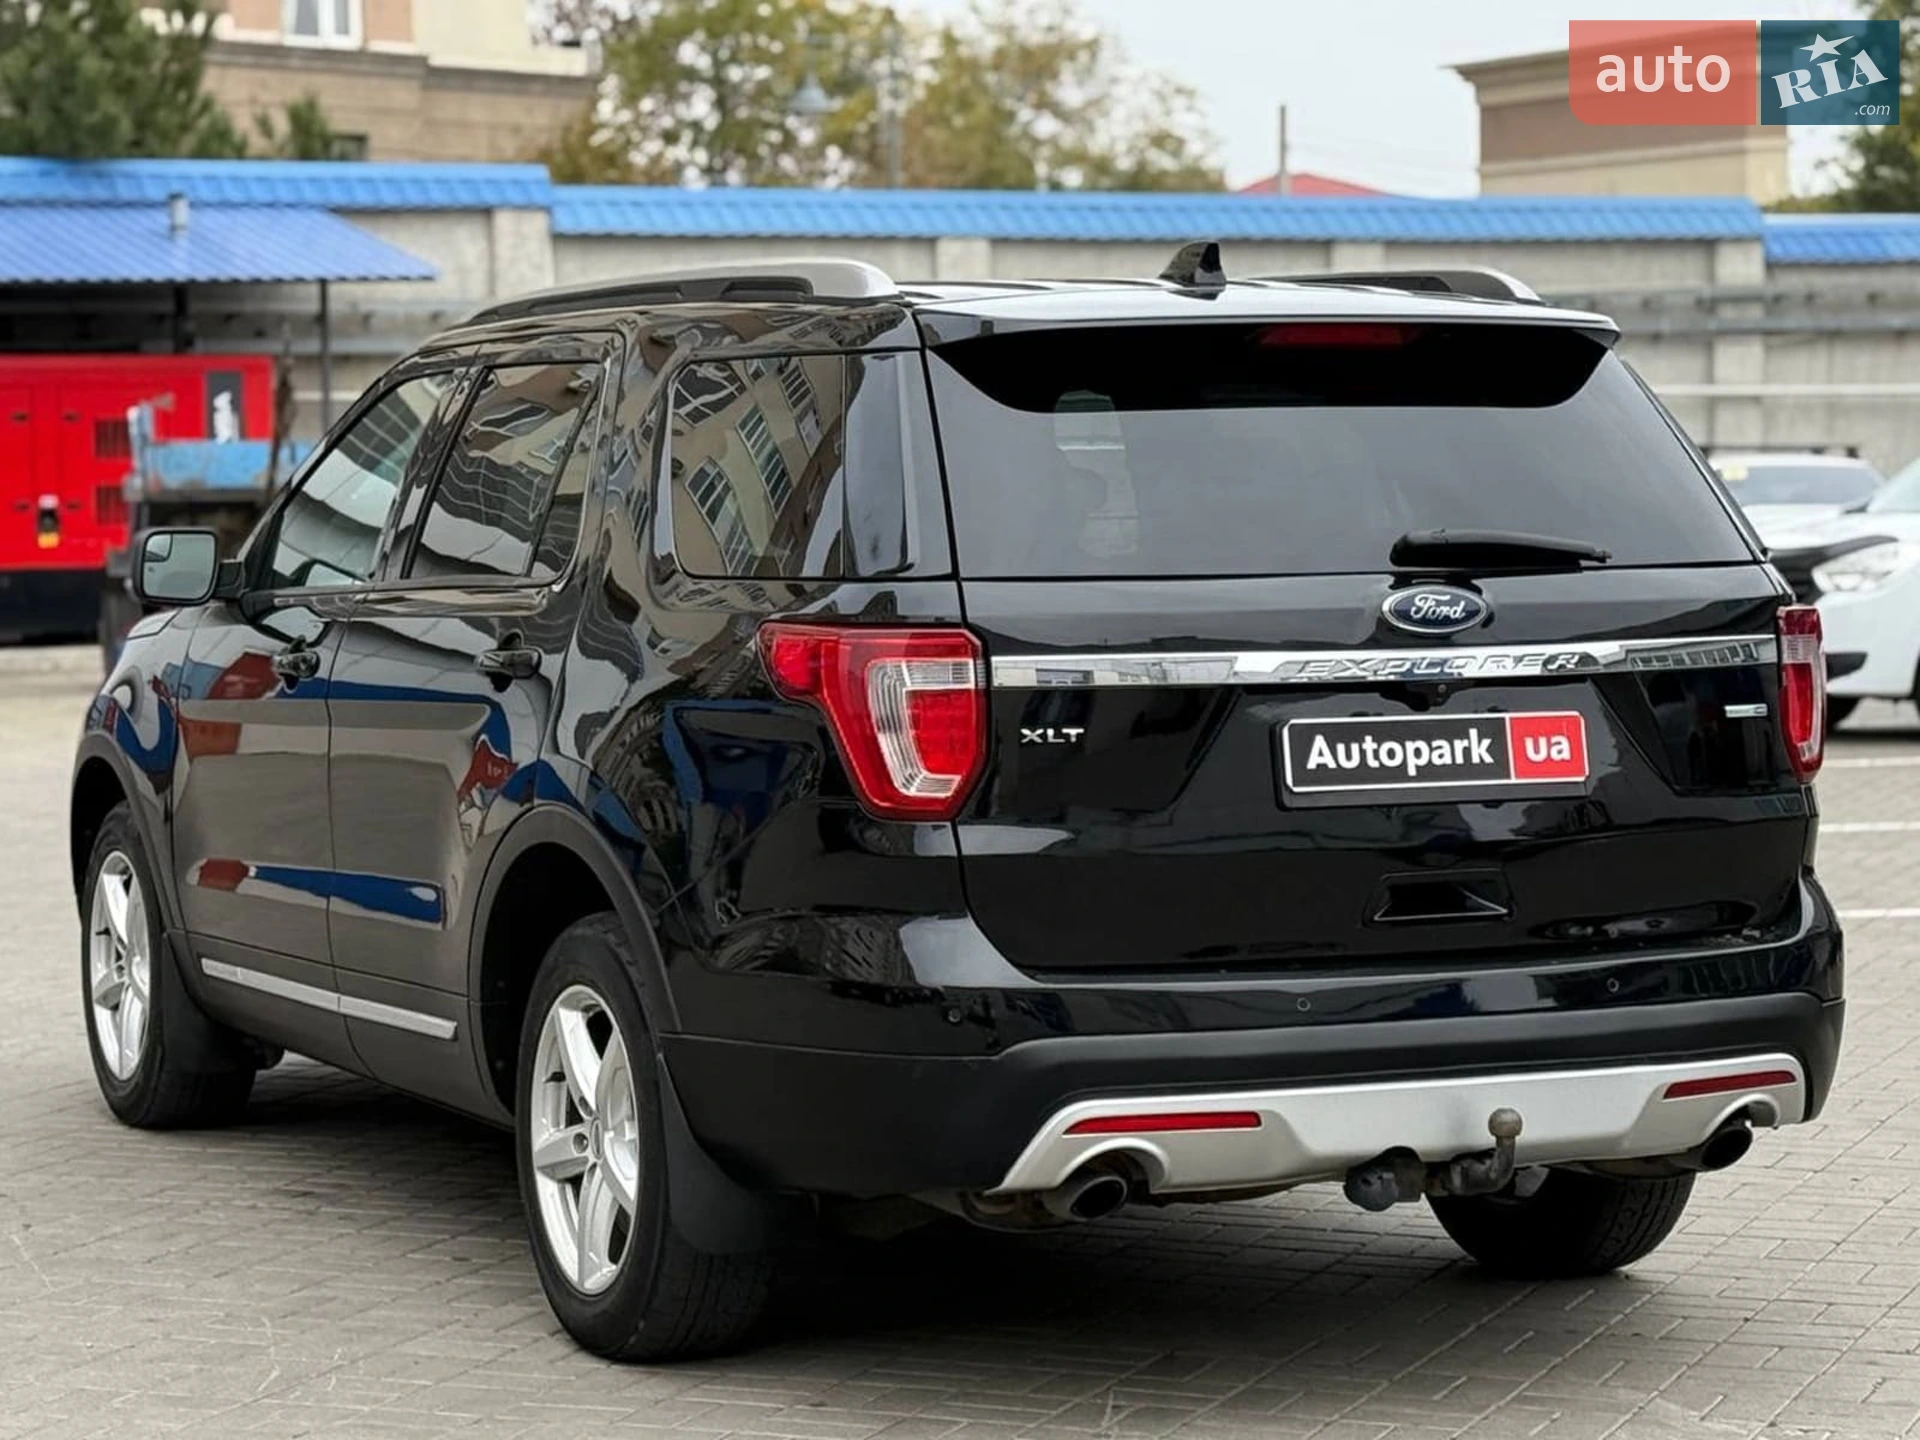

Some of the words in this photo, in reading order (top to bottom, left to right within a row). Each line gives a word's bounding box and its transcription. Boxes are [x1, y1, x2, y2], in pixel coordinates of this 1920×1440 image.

[1410, 593, 1466, 621] Ford
[1296, 652, 1581, 678] EXPLORER
[1020, 728, 1085, 743] XLT
[1306, 727, 1494, 777] Autopark
[1523, 734, 1572, 763] ua
